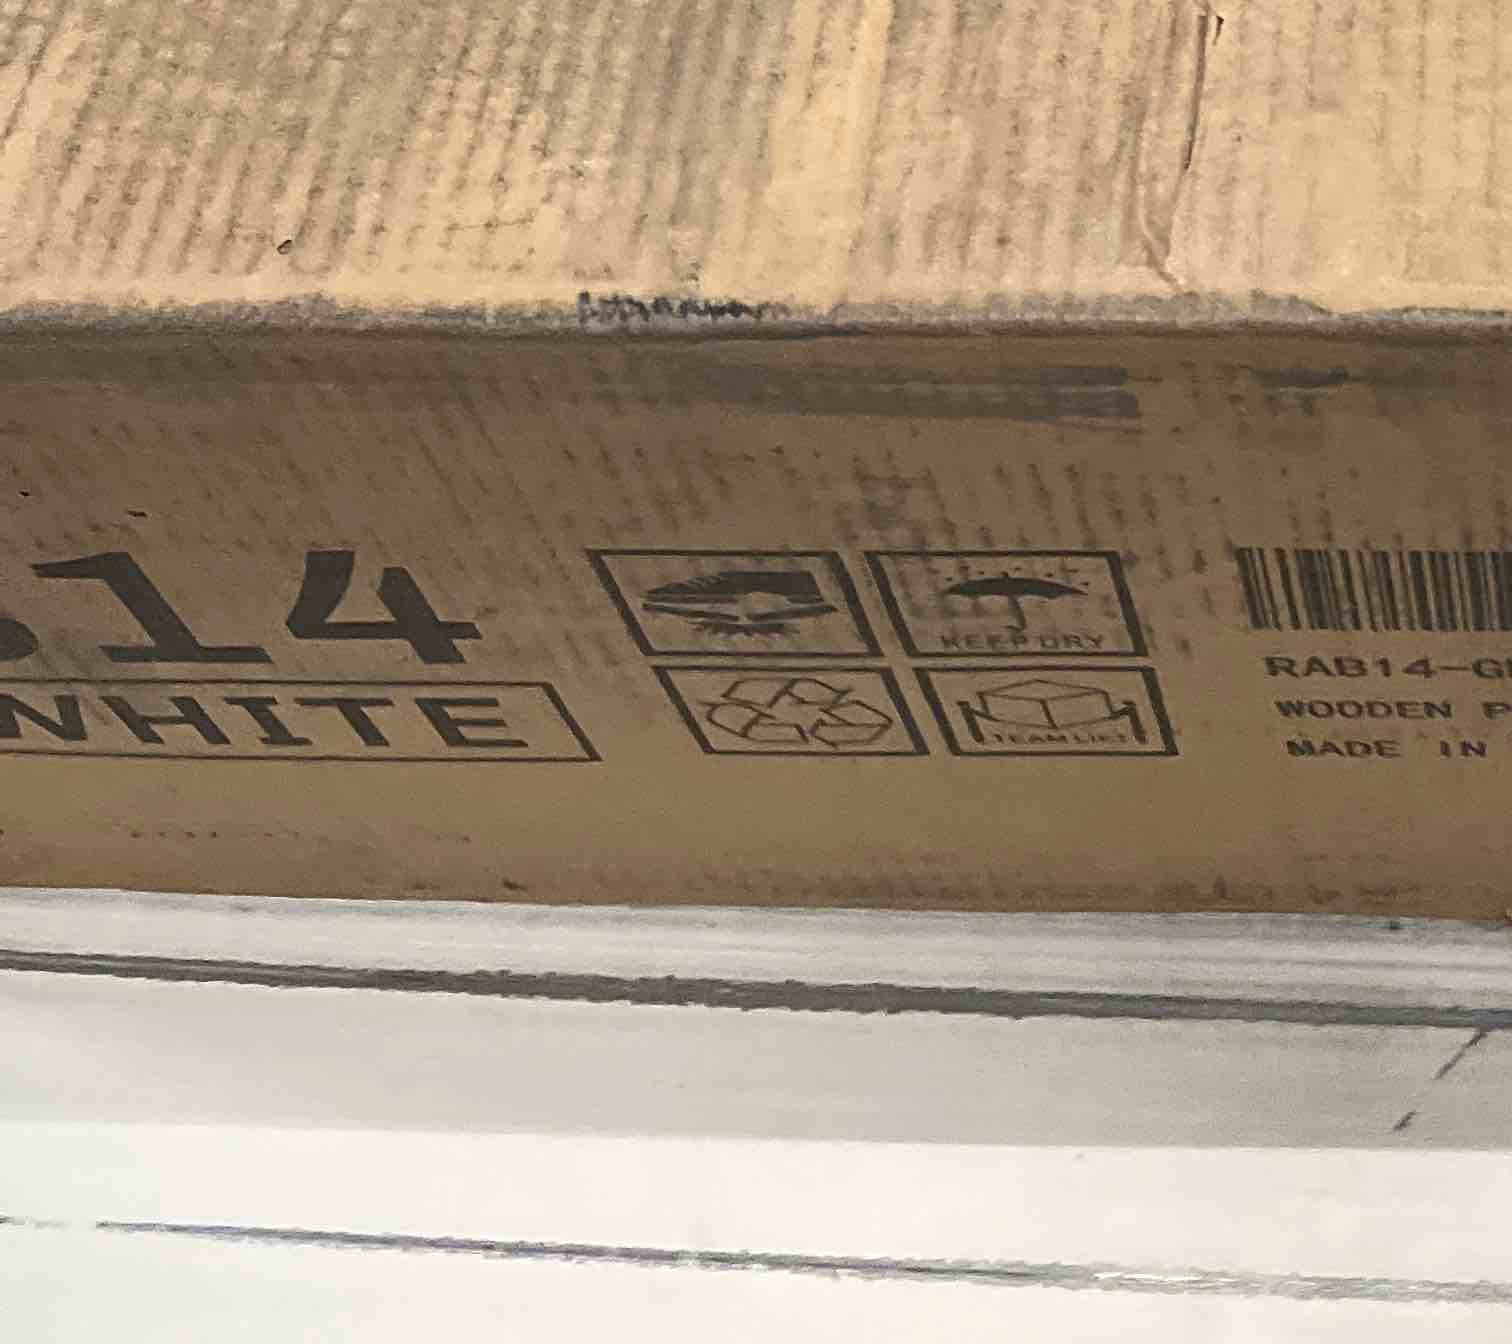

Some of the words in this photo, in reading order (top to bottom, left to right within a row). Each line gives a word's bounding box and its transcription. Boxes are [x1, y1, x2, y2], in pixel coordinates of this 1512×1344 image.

[0, 549, 482, 664] 14
[940, 633, 1028, 649] KEEP
[1040, 633, 1103, 649] DRY
[1275, 699, 1452, 721] WOODEN
[1286, 738, 1402, 759] MADE
[1440, 740, 1488, 759] IN
